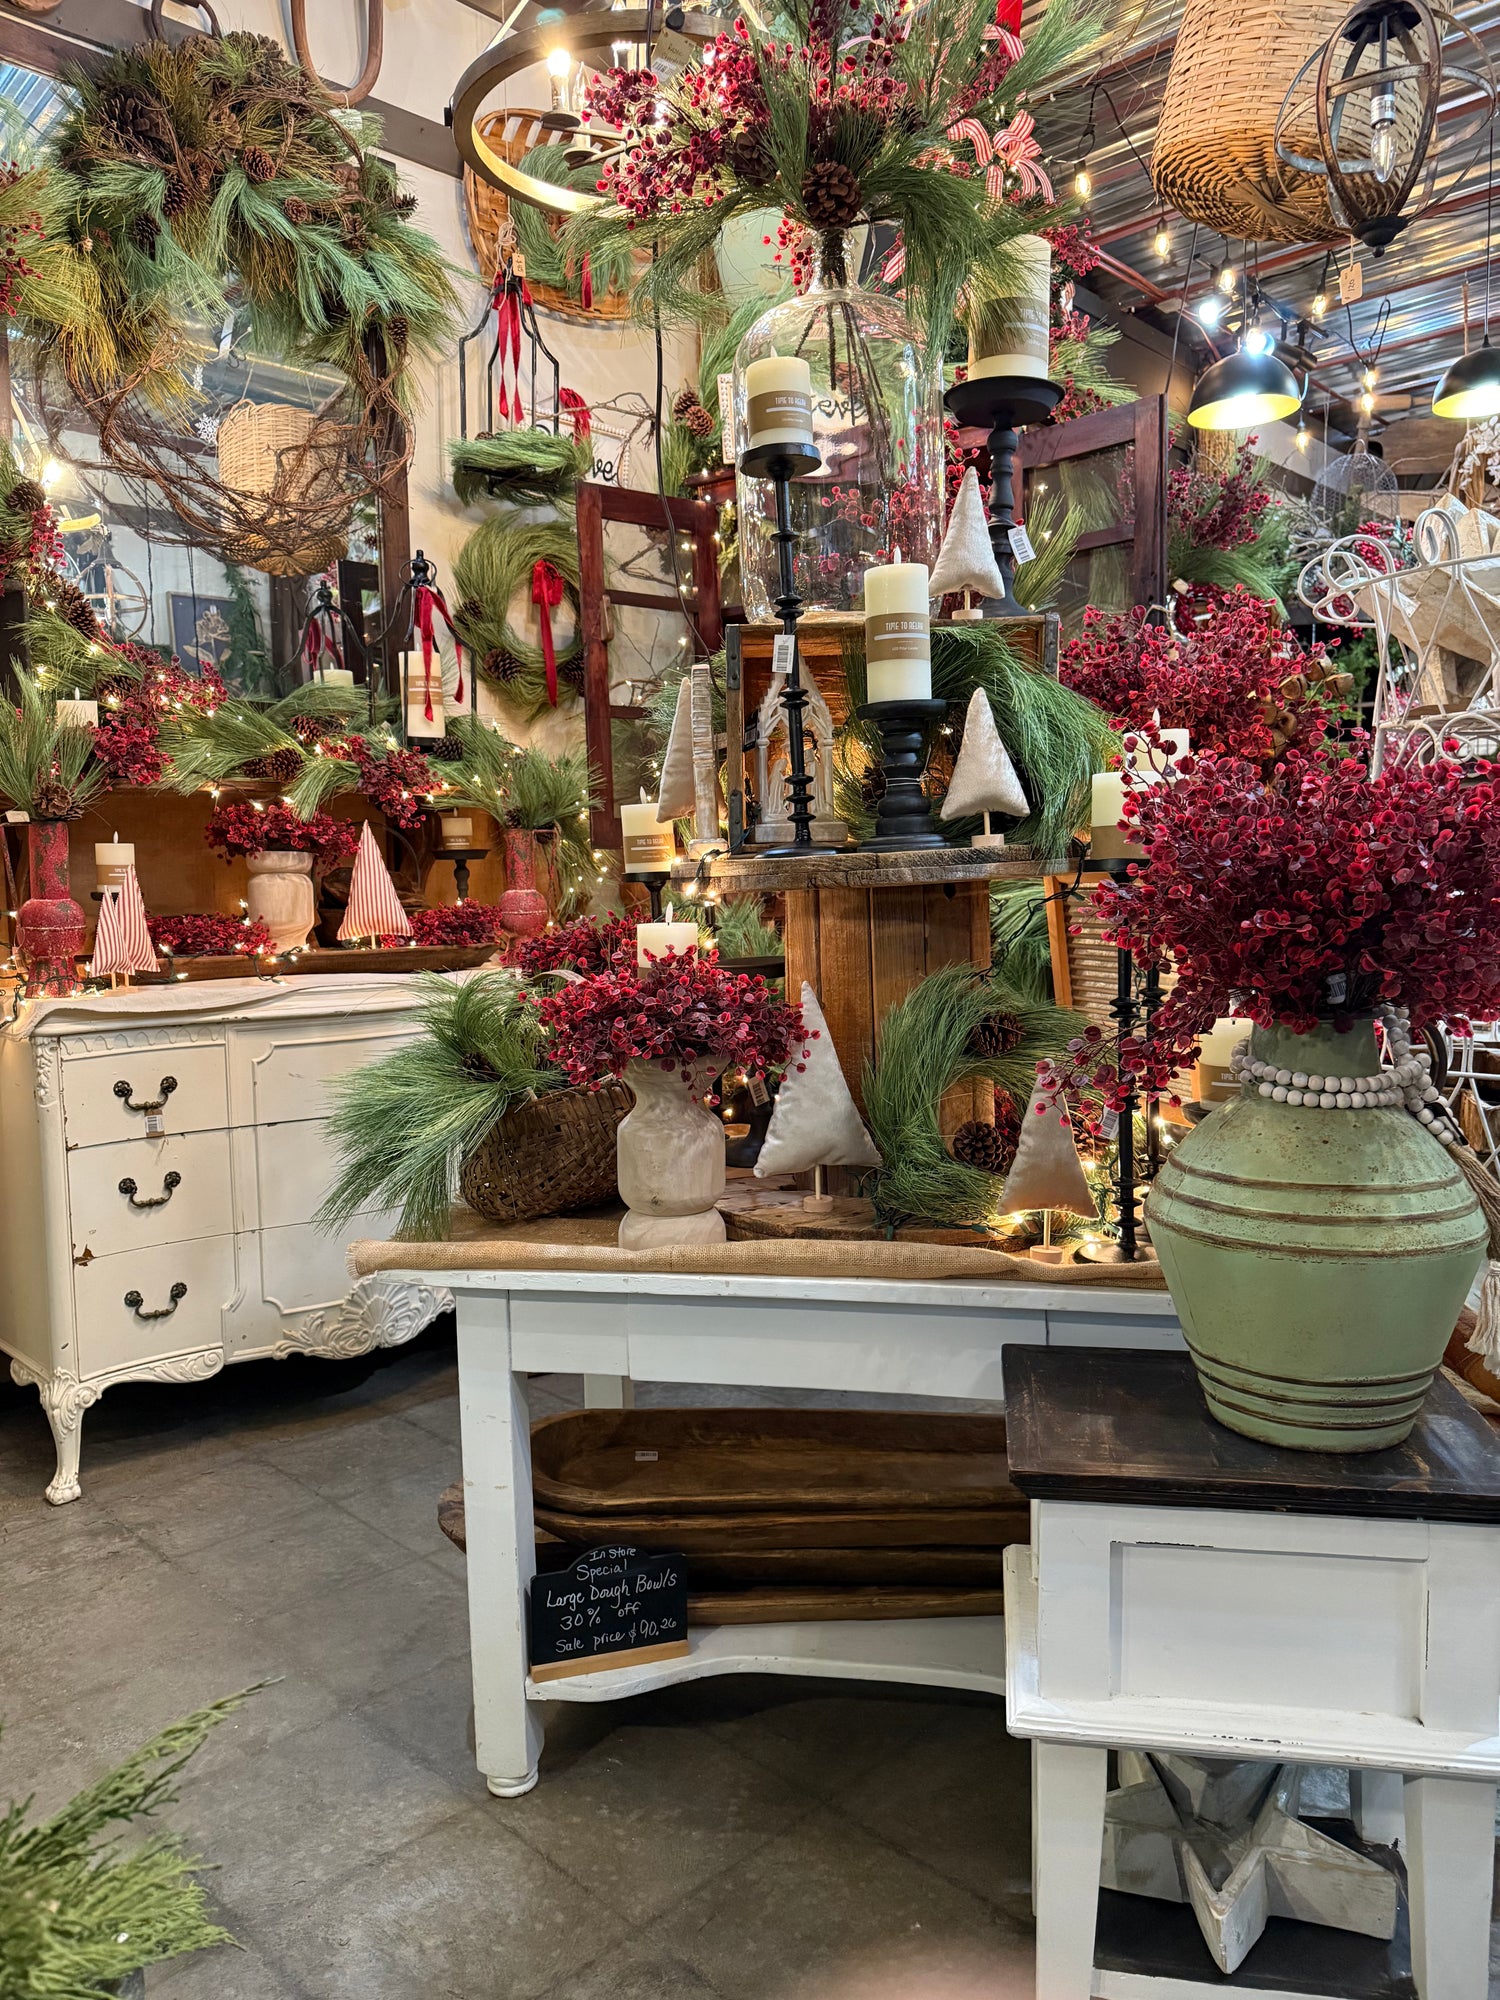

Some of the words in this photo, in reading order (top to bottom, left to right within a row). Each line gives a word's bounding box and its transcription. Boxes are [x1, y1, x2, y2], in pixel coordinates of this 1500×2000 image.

[589, 1550, 606, 1562] In
[608, 1547, 637, 1559] Store
[576, 1558, 628, 1583] Special
[546, 1589, 586, 1612] Large
[590, 1579, 631, 1609] Dough
[617, 1601, 642, 1618] off
[555, 1638, 585, 1654] Sale
[592, 1630, 626, 1652] price
